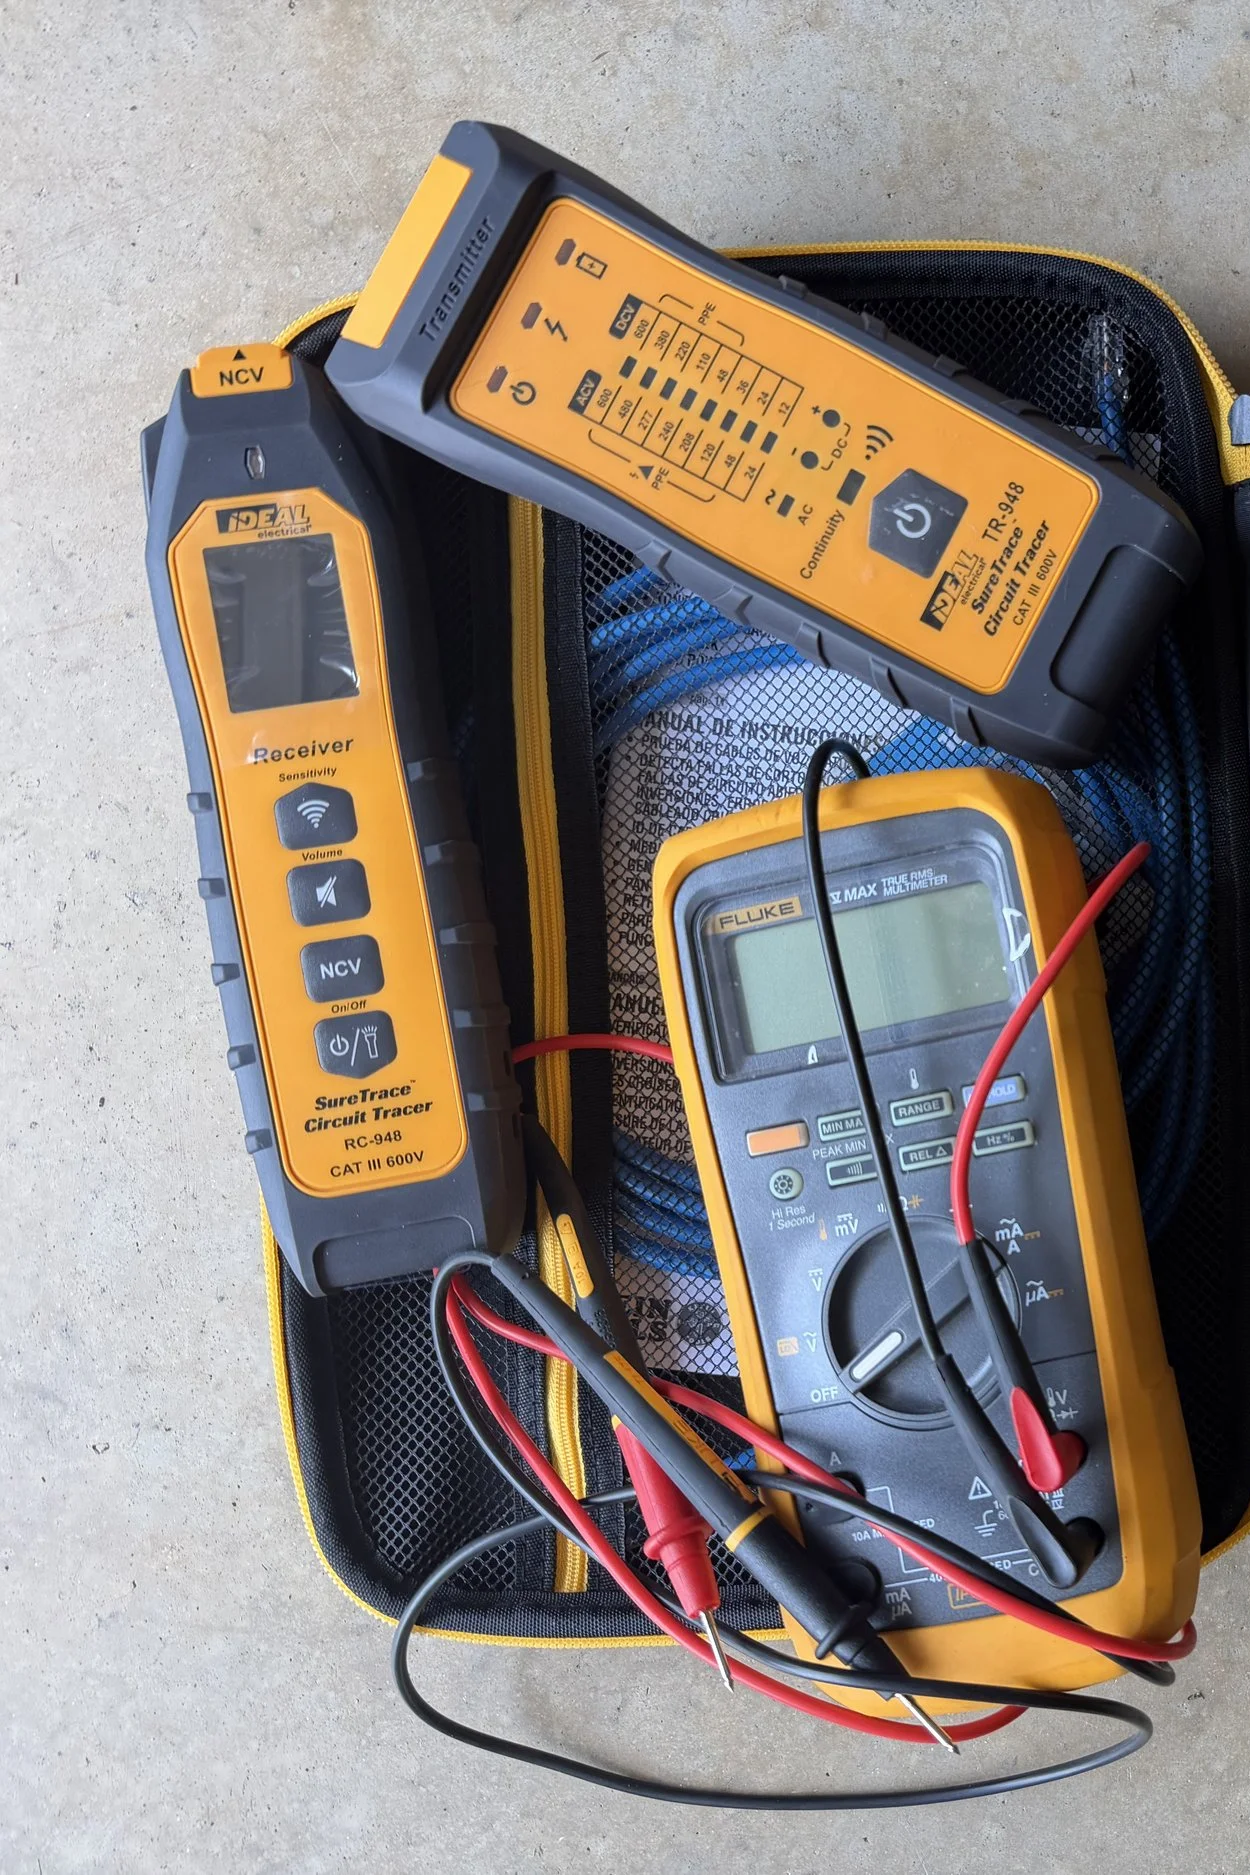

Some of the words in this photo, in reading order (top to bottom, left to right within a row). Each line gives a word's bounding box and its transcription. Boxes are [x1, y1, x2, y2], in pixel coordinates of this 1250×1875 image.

[419, 217, 494, 341] Transmitter
[615, 303, 636, 331] DCV
[697, 302, 716, 326] PPE
[634, 319, 649, 339] 600
[654, 330, 670, 350] 380
[675, 341, 691, 361] 220
[696, 353, 711, 371] 110
[219, 366, 264, 387] NCV
[717, 369, 729, 383] 48
[575, 378, 595, 406] ACV
[736, 380, 749, 394] 36
[597, 388, 612, 408] 600
[757, 391, 769, 406] 24
[618, 400, 633, 419] 480
[778, 402, 791, 415] 12
[638, 410, 653, 430] 277
[658, 421, 674, 441] 240
[679, 432, 695, 452] 208
[831, 438, 848, 459] DC
[700, 443, 715, 462] 120
[724, 454, 736, 468] 48
[651, 467, 669, 491] PPE
[744, 465, 757, 480] 24
[798, 504, 813, 526] AC
[981, 482, 1025, 542] TR-948
[799, 509, 845, 580] Continuity
[983, 578, 1021, 637] Circuit
[1013, 520, 1050, 577] Tracer
[1012, 599, 1032, 626] CAT
[1028, 584, 1040, 597] III
[1036, 549, 1058, 581] 600V
[640, 710, 706, 735] ANUAL
[253, 737, 354, 765] Receiver
[279, 766, 337, 782] Sensitivity
[302, 848, 343, 861] Volume
[881, 874, 908, 887] TRUE
[910, 868, 934, 882] RMS
[883, 875, 948, 897] MULTIMETER
[843, 883, 878, 903] MAX
[719, 901, 796, 929] FLUKE
[320, 958, 361, 980] NCV
[331, 1000, 367, 1014] On/Off
[304, 1112, 367, 1133] Circuit
[374, 1100, 433, 1122] Tracer
[899, 1101, 941, 1118] RANGE
[822, 1121, 844, 1135] MIN
[845, 1117, 863, 1129] MA
[345, 1131, 402, 1150] RC-948
[813, 1145, 844, 1160] PEAK
[846, 1140, 867, 1153] MIN
[986, 1135, 1002, 1147] Hz
[330, 1162, 361, 1178] CAT
[368, 1159, 381, 1172] III
[387, 1151, 425, 1169] 600V
[909, 1152, 933, 1163] REL
[786, 1205, 806, 1217] Res
[777, 1212, 816, 1231] Second
[1007, 1239, 1021, 1255] A
[811, 1386, 838, 1403] OFF
[852, 1530, 871, 1542] 10A
[885, 1587, 912, 1605] mA
